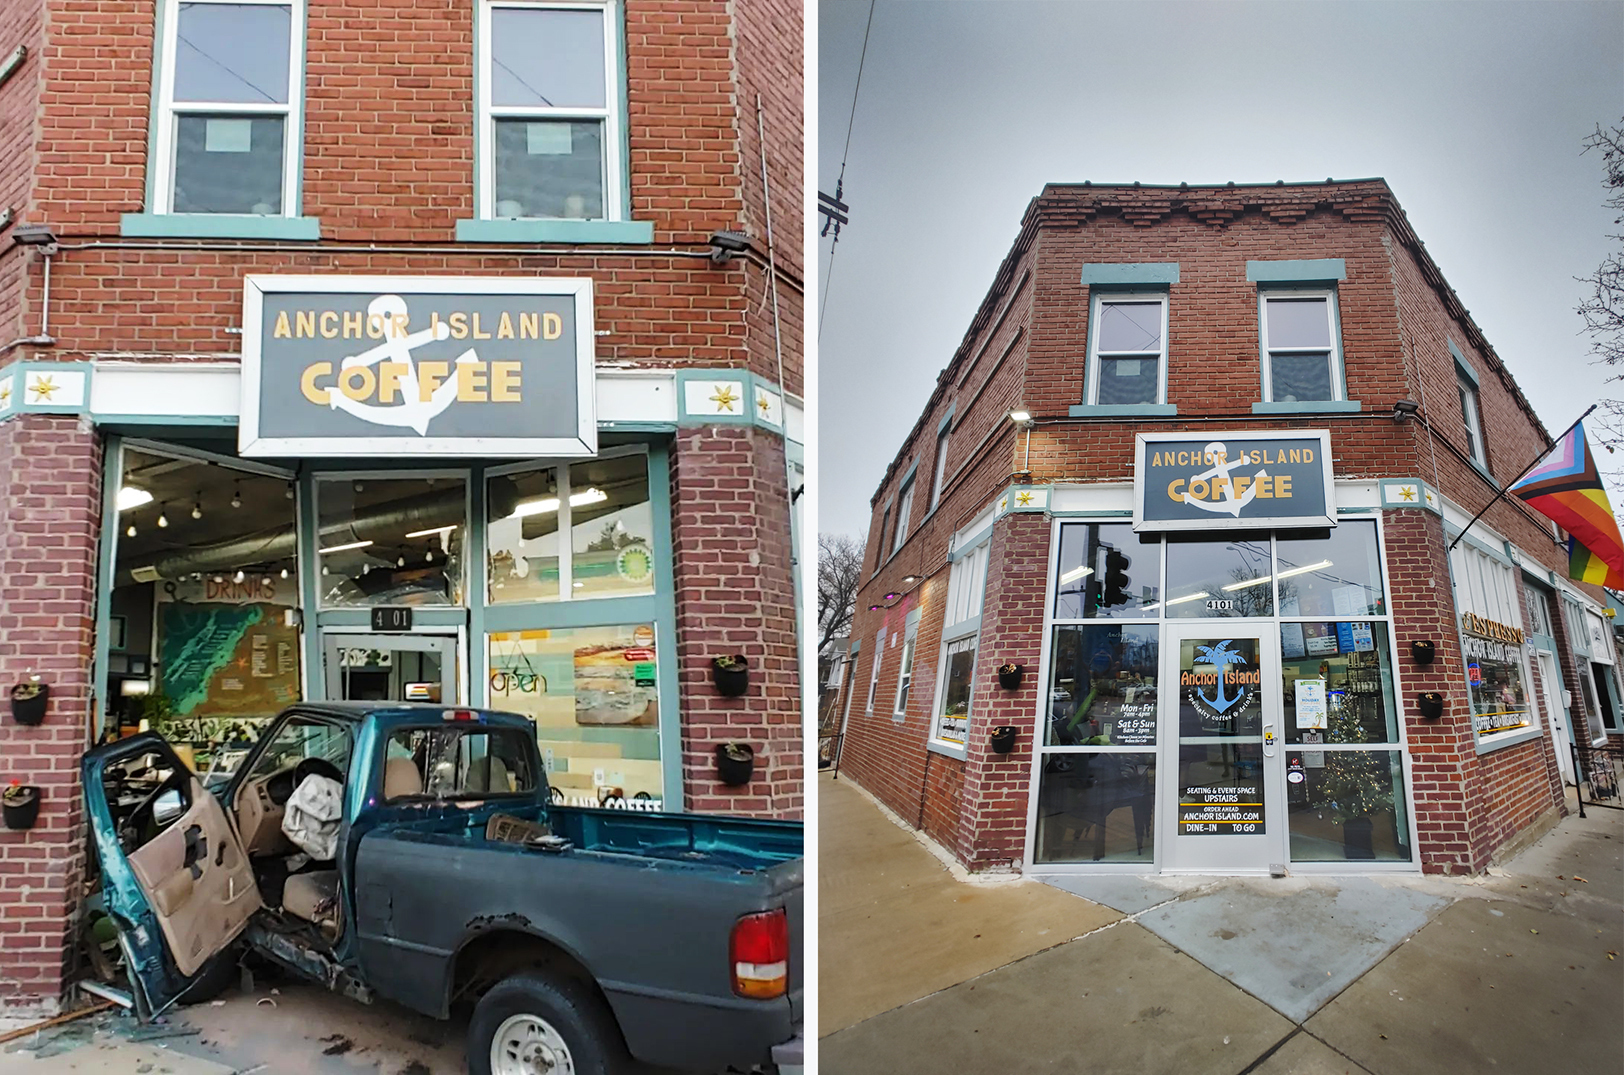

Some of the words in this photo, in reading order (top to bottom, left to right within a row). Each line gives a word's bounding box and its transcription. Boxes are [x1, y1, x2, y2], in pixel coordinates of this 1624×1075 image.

[274, 311, 410, 340] ANCHOR
[431, 312, 562, 340] ISLAND
[300, 361, 522, 406] COFFEE
[1152, 451, 1228, 467] ANCHOR
[1240, 448, 1314, 465] ISLAND
[1167, 475, 1292, 503] COFFEE
[206, 579, 277, 600] DRINKS
[1206, 600, 1232, 609] 4101
[1470, 612, 1524, 644] ESPRESSO
[491, 672, 548, 697] open
[1181, 670, 1218, 686] Anchor
[1224, 669, 1260, 685] Island
[1120, 704, 1138, 712] Mon
[1143, 703, 1154, 712] Fri
[1188, 693, 1211, 719] specialty
[1239, 692, 1254, 713] drinks
[1117, 719, 1131, 728] Sat
[1132, 719, 1139, 728] &
[1140, 719, 1155, 728] Sun
[1204, 794, 1238, 803] UPSTAIRS
[1186, 823, 1218, 832] DINE-IN
[1232, 823, 1243, 832] TO
[1243, 823, 1256, 832] GO
